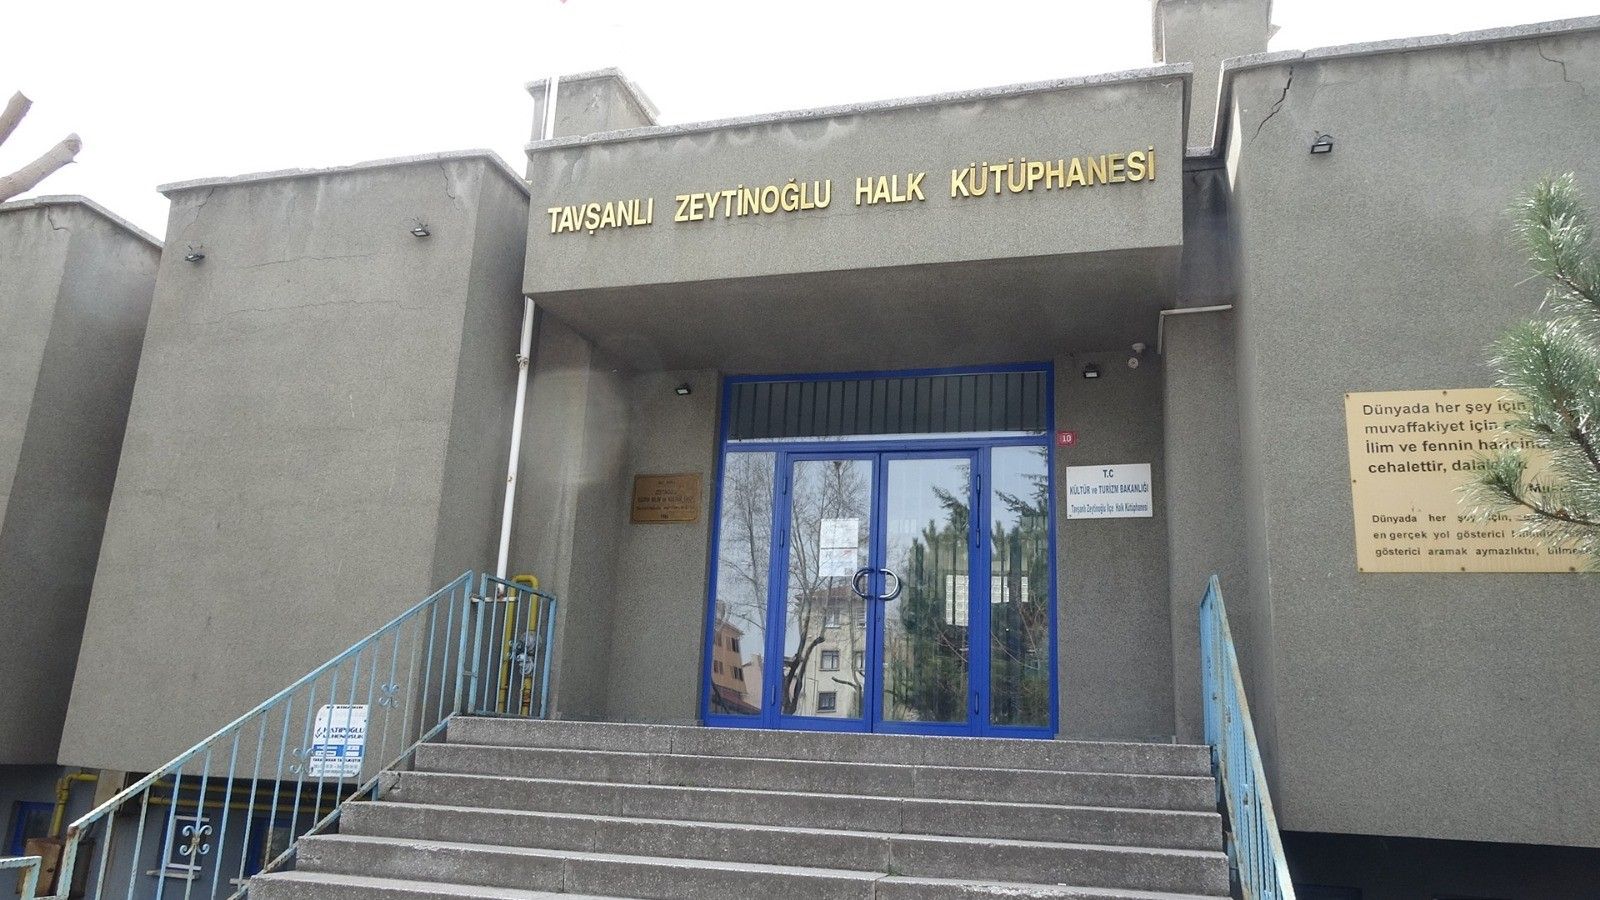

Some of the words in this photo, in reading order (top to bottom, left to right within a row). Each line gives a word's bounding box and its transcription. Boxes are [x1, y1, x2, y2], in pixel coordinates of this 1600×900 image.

[547, 198, 654, 235] TAVŞANLI
[674, 178, 832, 223] ZEYTİNOĞLU
[855, 171, 926, 206] HALK
[951, 146, 1156, 198] KÜTÜPHANESİ
[1363, 403, 1430, 417] Dünyada
[1435, 402, 1461, 413] her
[1465, 403, 1492, 414] şey
[1365, 420, 1465, 434] muvaffakiyet
[1470, 420, 1498, 432] için
[1062, 434, 1072, 443] 10
[1366, 440, 1394, 454] İlim
[1399, 443, 1418, 452] ve
[1422, 440, 1473, 452] fennin
[1368, 460, 1447, 473] cehalettir,
[1069, 484, 1091, 496] KÜLTÜR
[1091, 487, 1098, 495] ve
[1098, 483, 1120, 494] TURİZM
[1120, 481, 1149, 494] BAKANLIĞI
[1372, 514, 1418, 524] Dünyada
[1428, 514, 1447, 522] her
[1389, 531, 1428, 541] gerçek
[1433, 531, 1450, 540] yol
[1456, 530, 1505, 541] gösterici
[1375, 547, 1421, 557] gösterici
[1428, 547, 1468, 556] aramak
